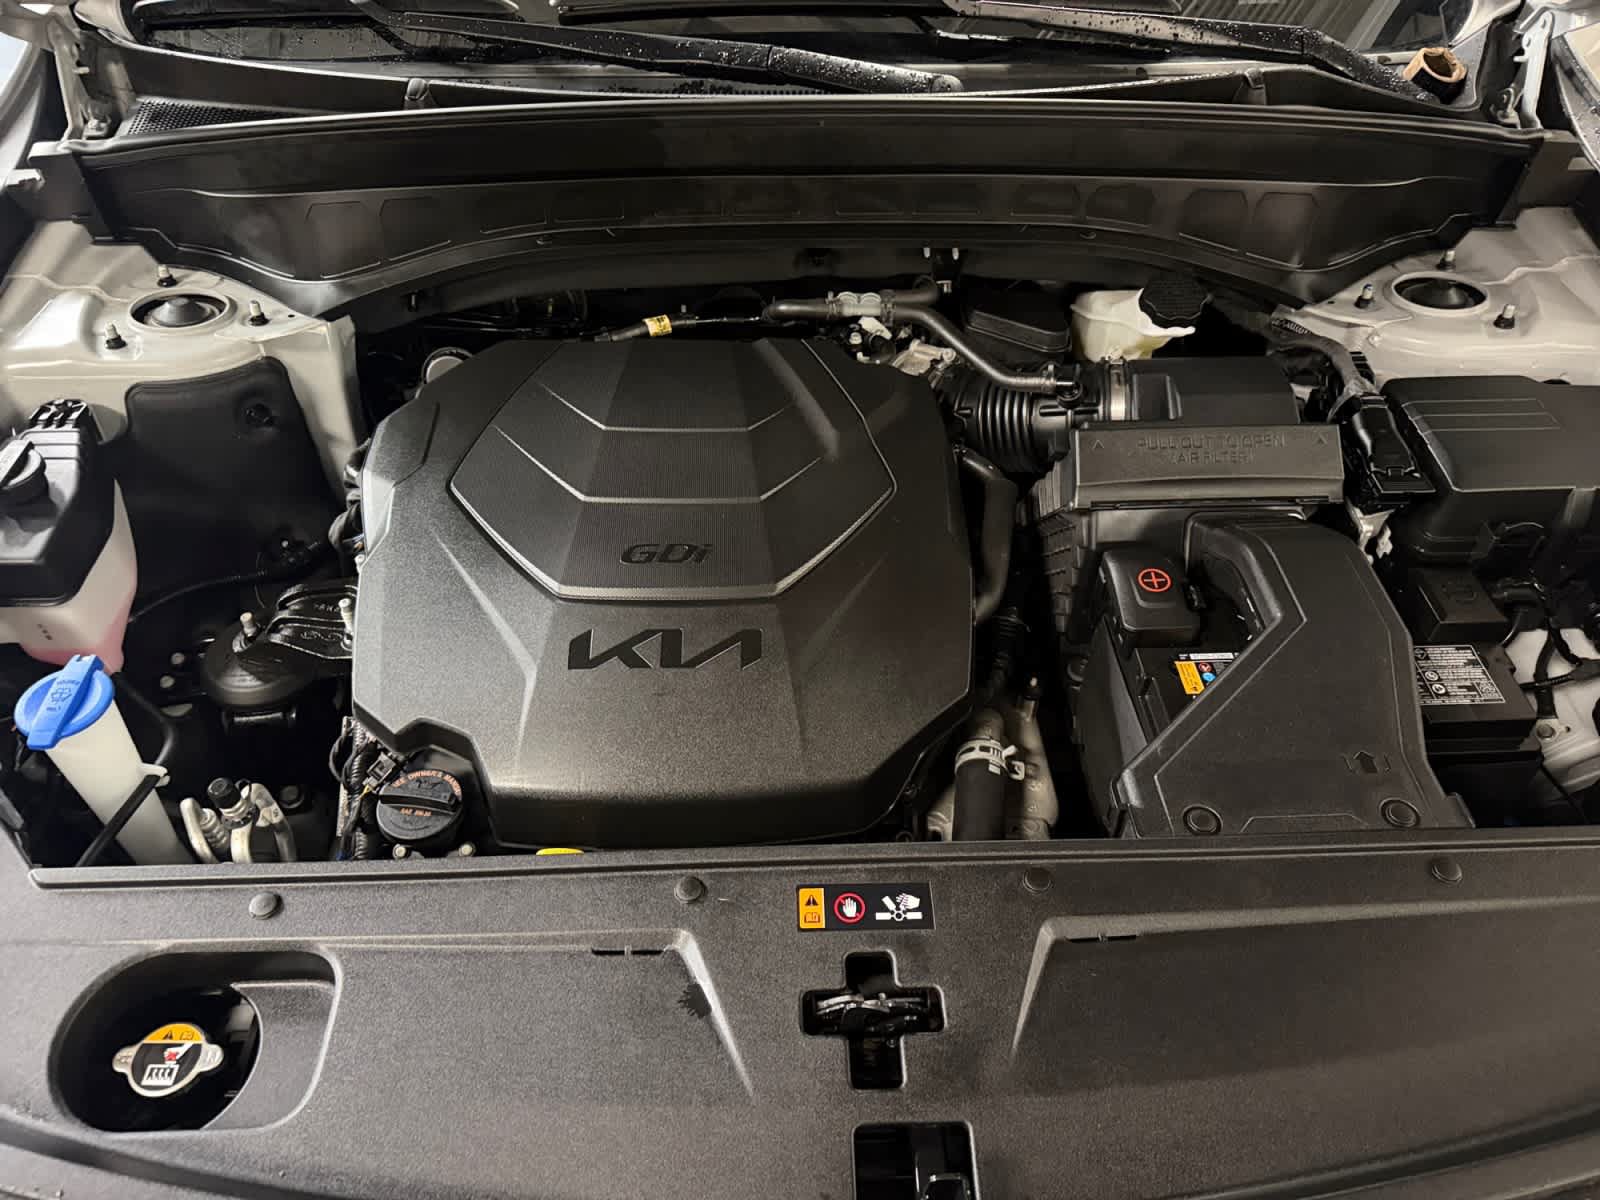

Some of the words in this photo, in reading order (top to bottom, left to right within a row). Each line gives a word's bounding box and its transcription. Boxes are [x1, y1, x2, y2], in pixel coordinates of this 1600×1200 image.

[1137, 434, 1178, 450] PULL
[1181, 434, 1212, 450] OUT
[619, 543, 714, 565] GDi
[567, 628, 763, 671] KIA
